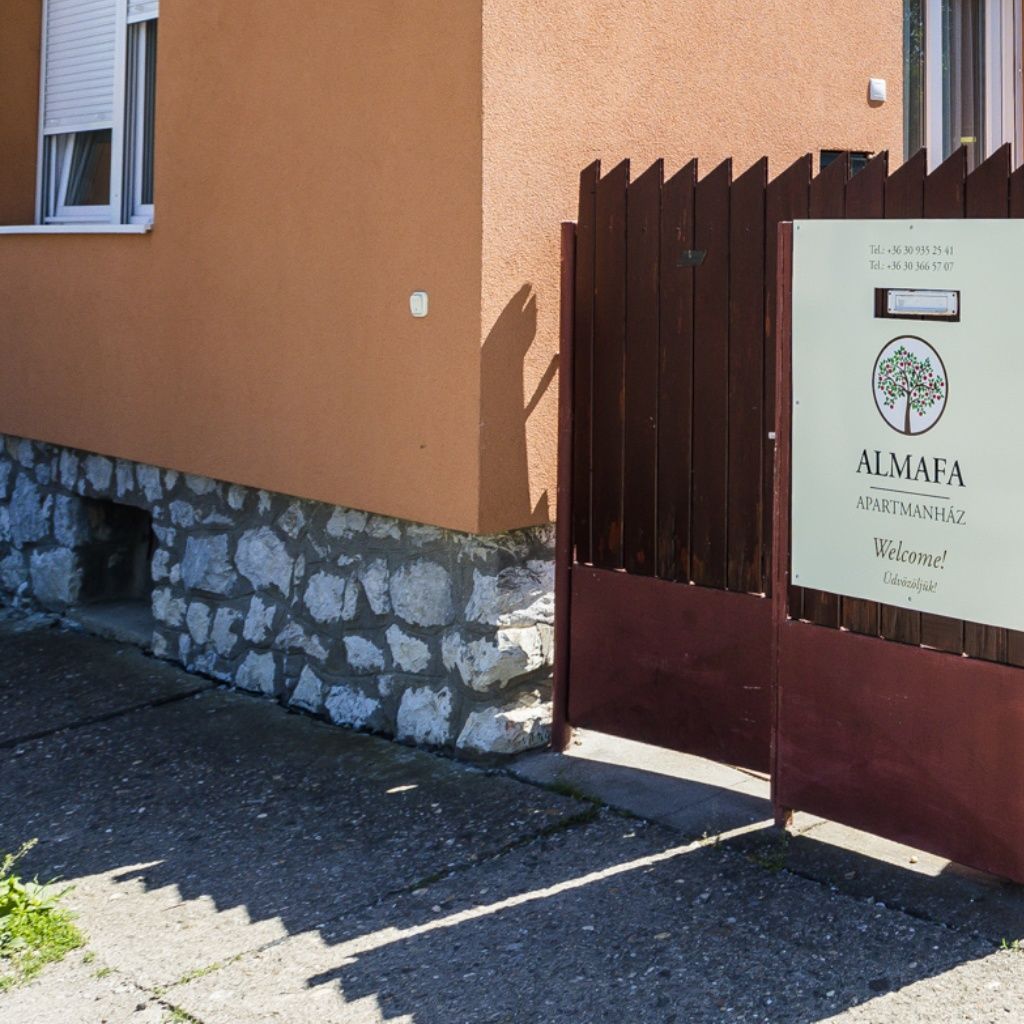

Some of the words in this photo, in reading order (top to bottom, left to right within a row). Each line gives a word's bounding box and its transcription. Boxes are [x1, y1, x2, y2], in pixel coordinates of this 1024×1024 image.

[869, 244, 885, 255] Tel.:
[887, 245, 902, 255] +36
[903, 245, 914, 255] 30
[915, 245, 930, 255] 935
[932, 246, 942, 256] 25
[944, 246, 954, 256] 41
[869, 260, 885, 270] Tel.:
[887, 261, 902, 271] +36
[903, 261, 913, 271] 30
[915, 261, 930, 272] 366
[932, 261, 942, 272] 57
[944, 261, 954, 272] 07
[856, 448, 967, 488] ALMAFA
[856, 495, 967, 525] APARTMANHÁZ
[873, 537, 947, 570] Welcome!
